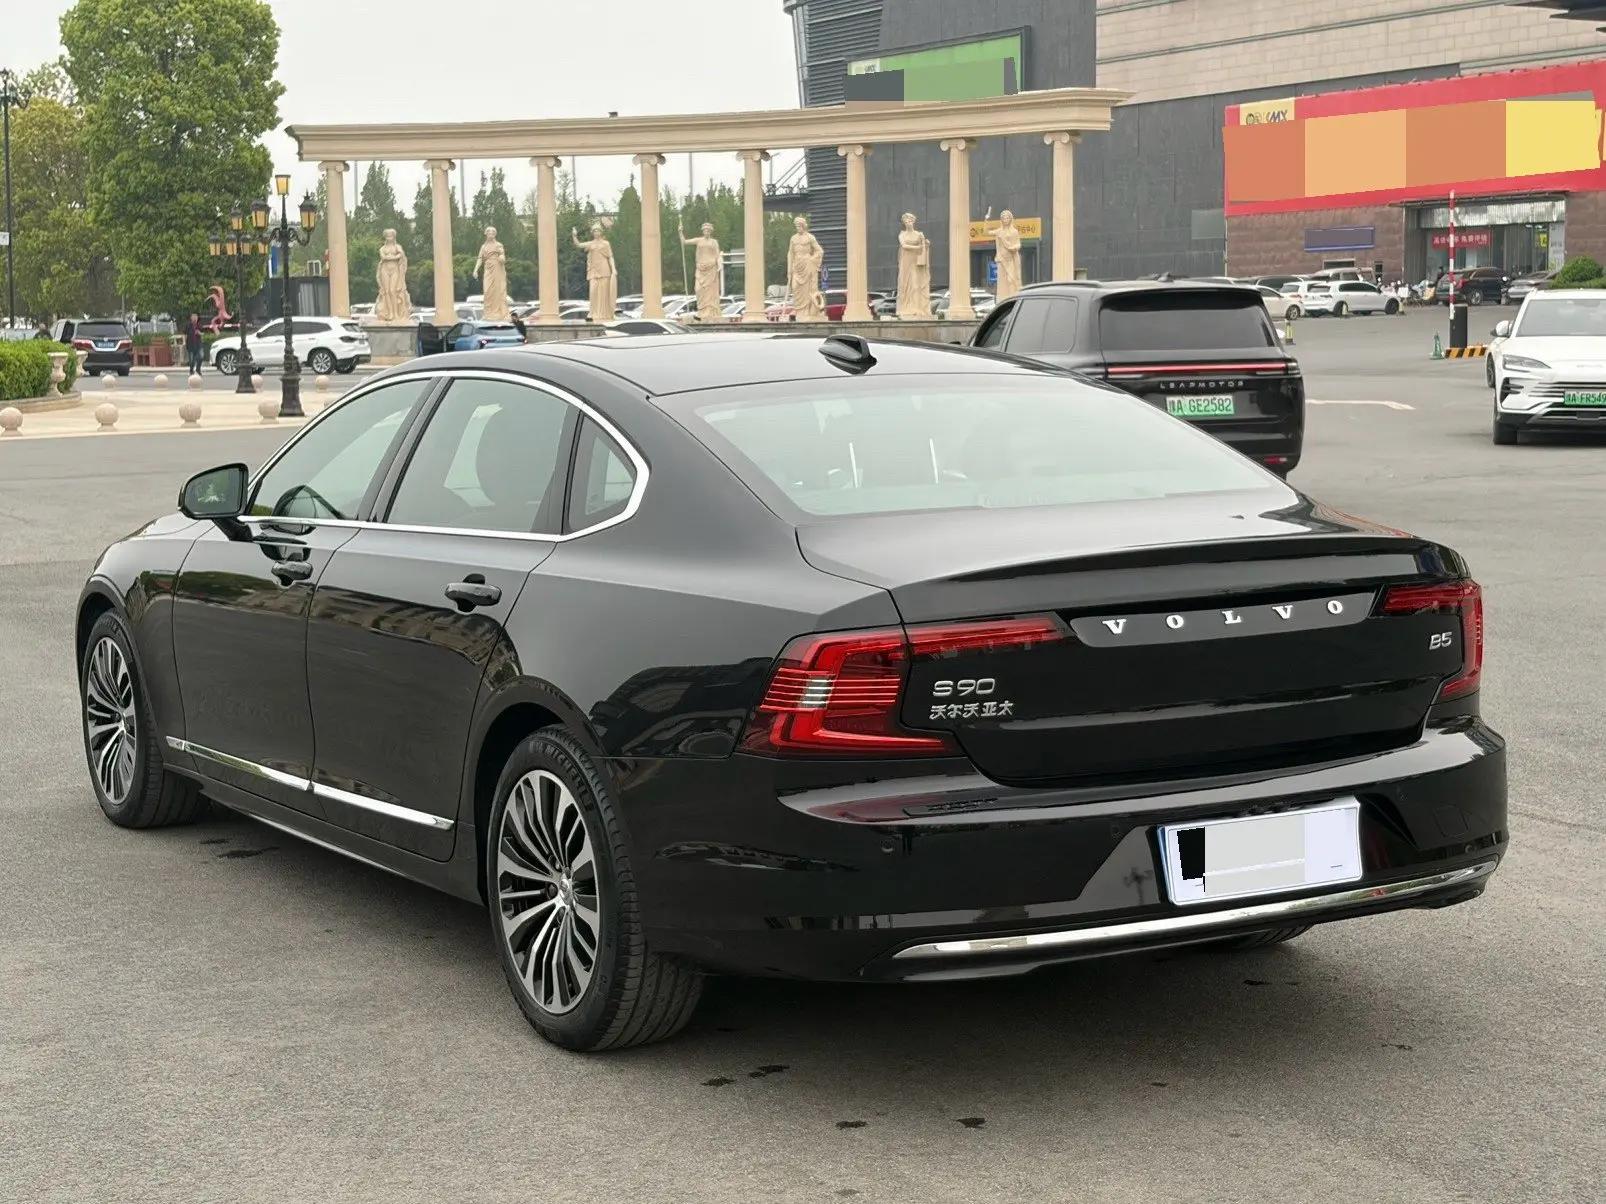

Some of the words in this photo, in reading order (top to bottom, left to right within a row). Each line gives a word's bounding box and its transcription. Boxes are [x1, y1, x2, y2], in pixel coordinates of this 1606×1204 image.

[1160, 380, 1245, 389] LEAPMOTOR
[1189, 397, 1232, 413] GE2582
[1102, 600, 1343, 634] VOLVO
[1428, 631, 1453, 649] B5
[932, 678, 995, 697] S90
[929, 700, 1013, 720] 沃尔沃亚太
